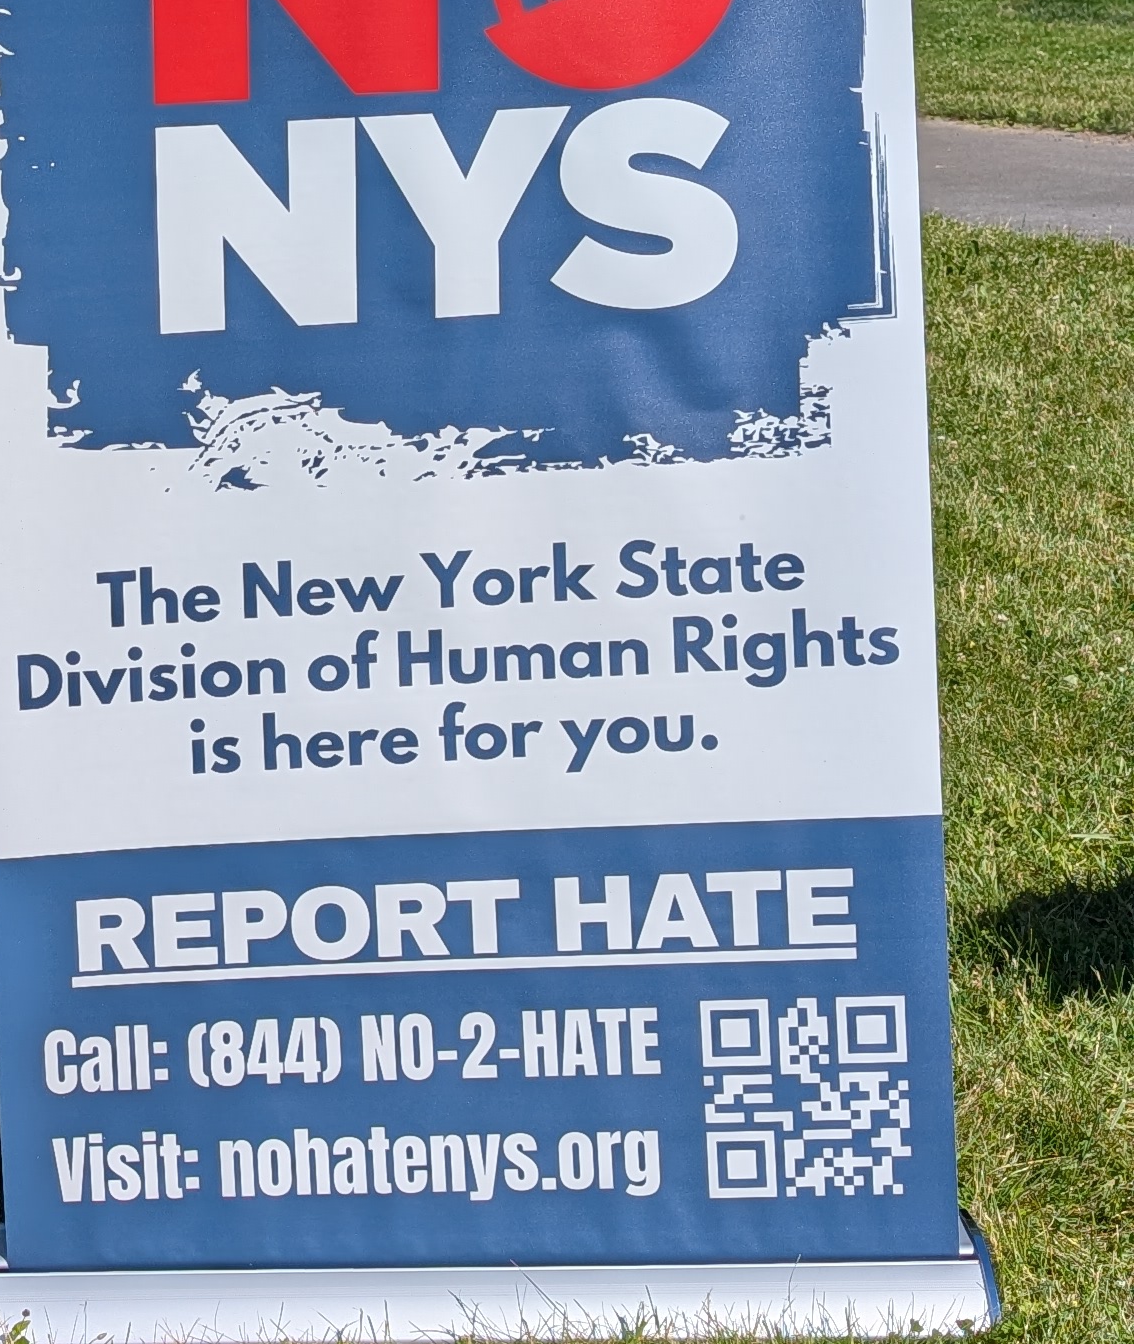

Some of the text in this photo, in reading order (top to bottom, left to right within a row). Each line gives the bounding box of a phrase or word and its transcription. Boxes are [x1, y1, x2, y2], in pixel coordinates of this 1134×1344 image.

[154, 97, 739, 335] NYS
[96, 539, 805, 628] The New York State
[16, 607, 900, 711] Division of Human Rights
[190, 701, 719, 775] is here for you.
[75, 867, 857, 973] REPORT HATE
[43, 1007, 662, 1095] Call: (844) NO-2-HATE
[51, 1126, 661, 1203] Visit: nohatenys.org
